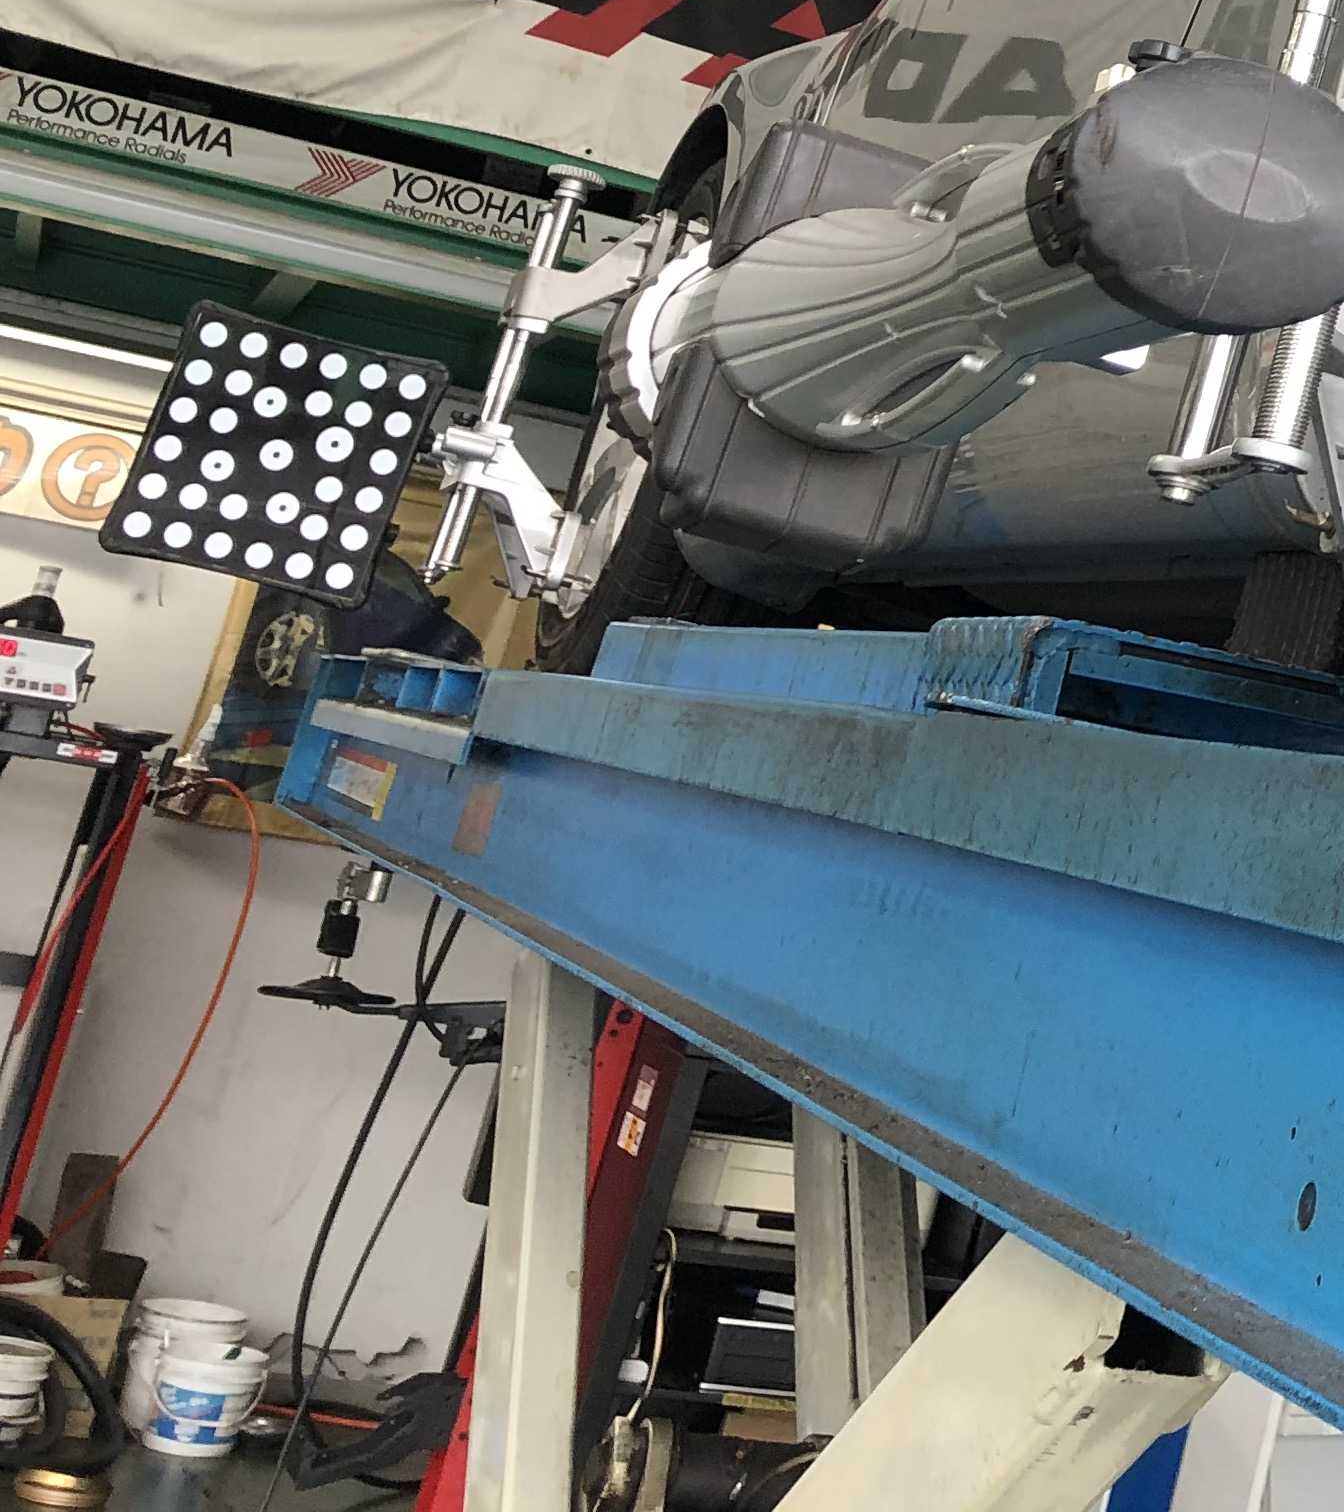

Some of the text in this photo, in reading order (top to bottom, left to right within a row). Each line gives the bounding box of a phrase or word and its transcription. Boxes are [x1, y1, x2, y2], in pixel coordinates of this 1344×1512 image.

[7, 108, 187, 165] Performance Radials
[16, 76, 233, 158] YOKOHAMA
[383, 199, 538, 248] Performance Radia
